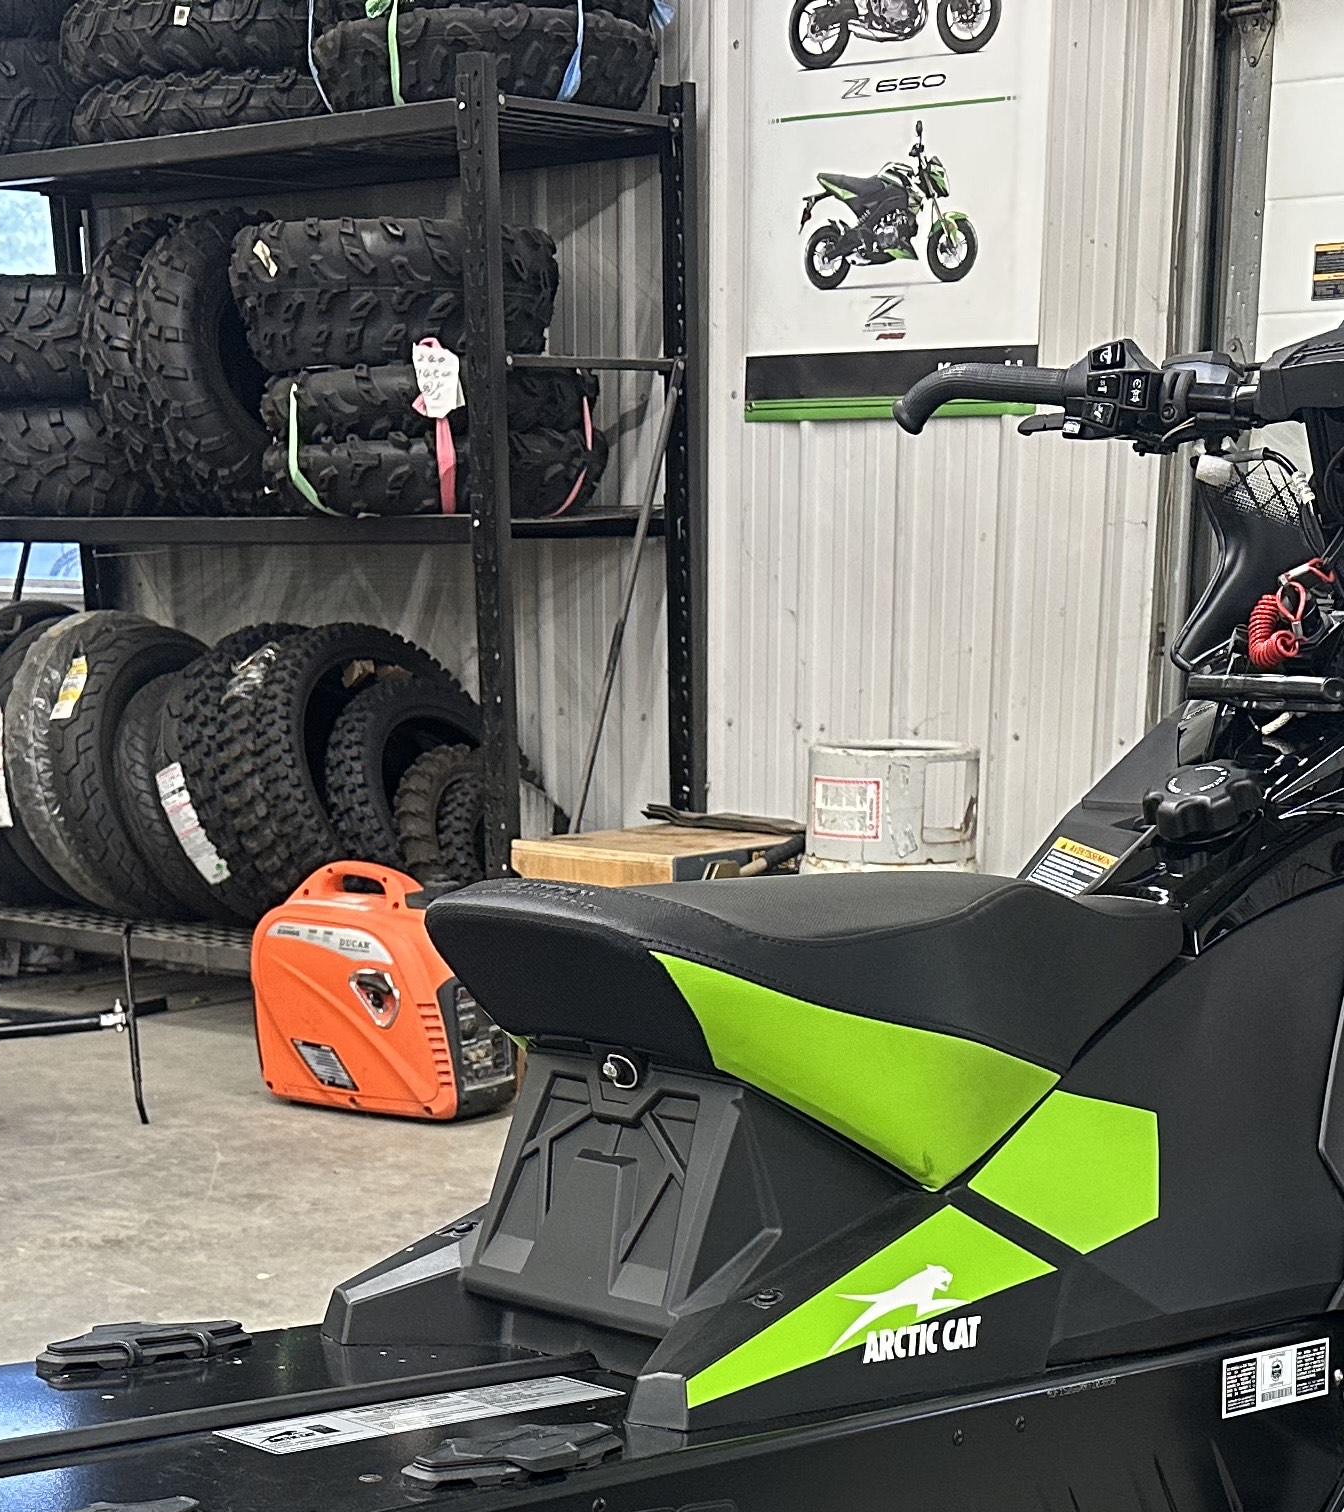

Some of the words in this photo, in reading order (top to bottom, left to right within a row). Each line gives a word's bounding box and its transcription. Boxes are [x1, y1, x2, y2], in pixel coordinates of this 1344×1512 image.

[875, 73, 947, 93] 650
[862, 1321, 940, 1364] ARCTIC
[942, 1315, 982, 1351] CAT
